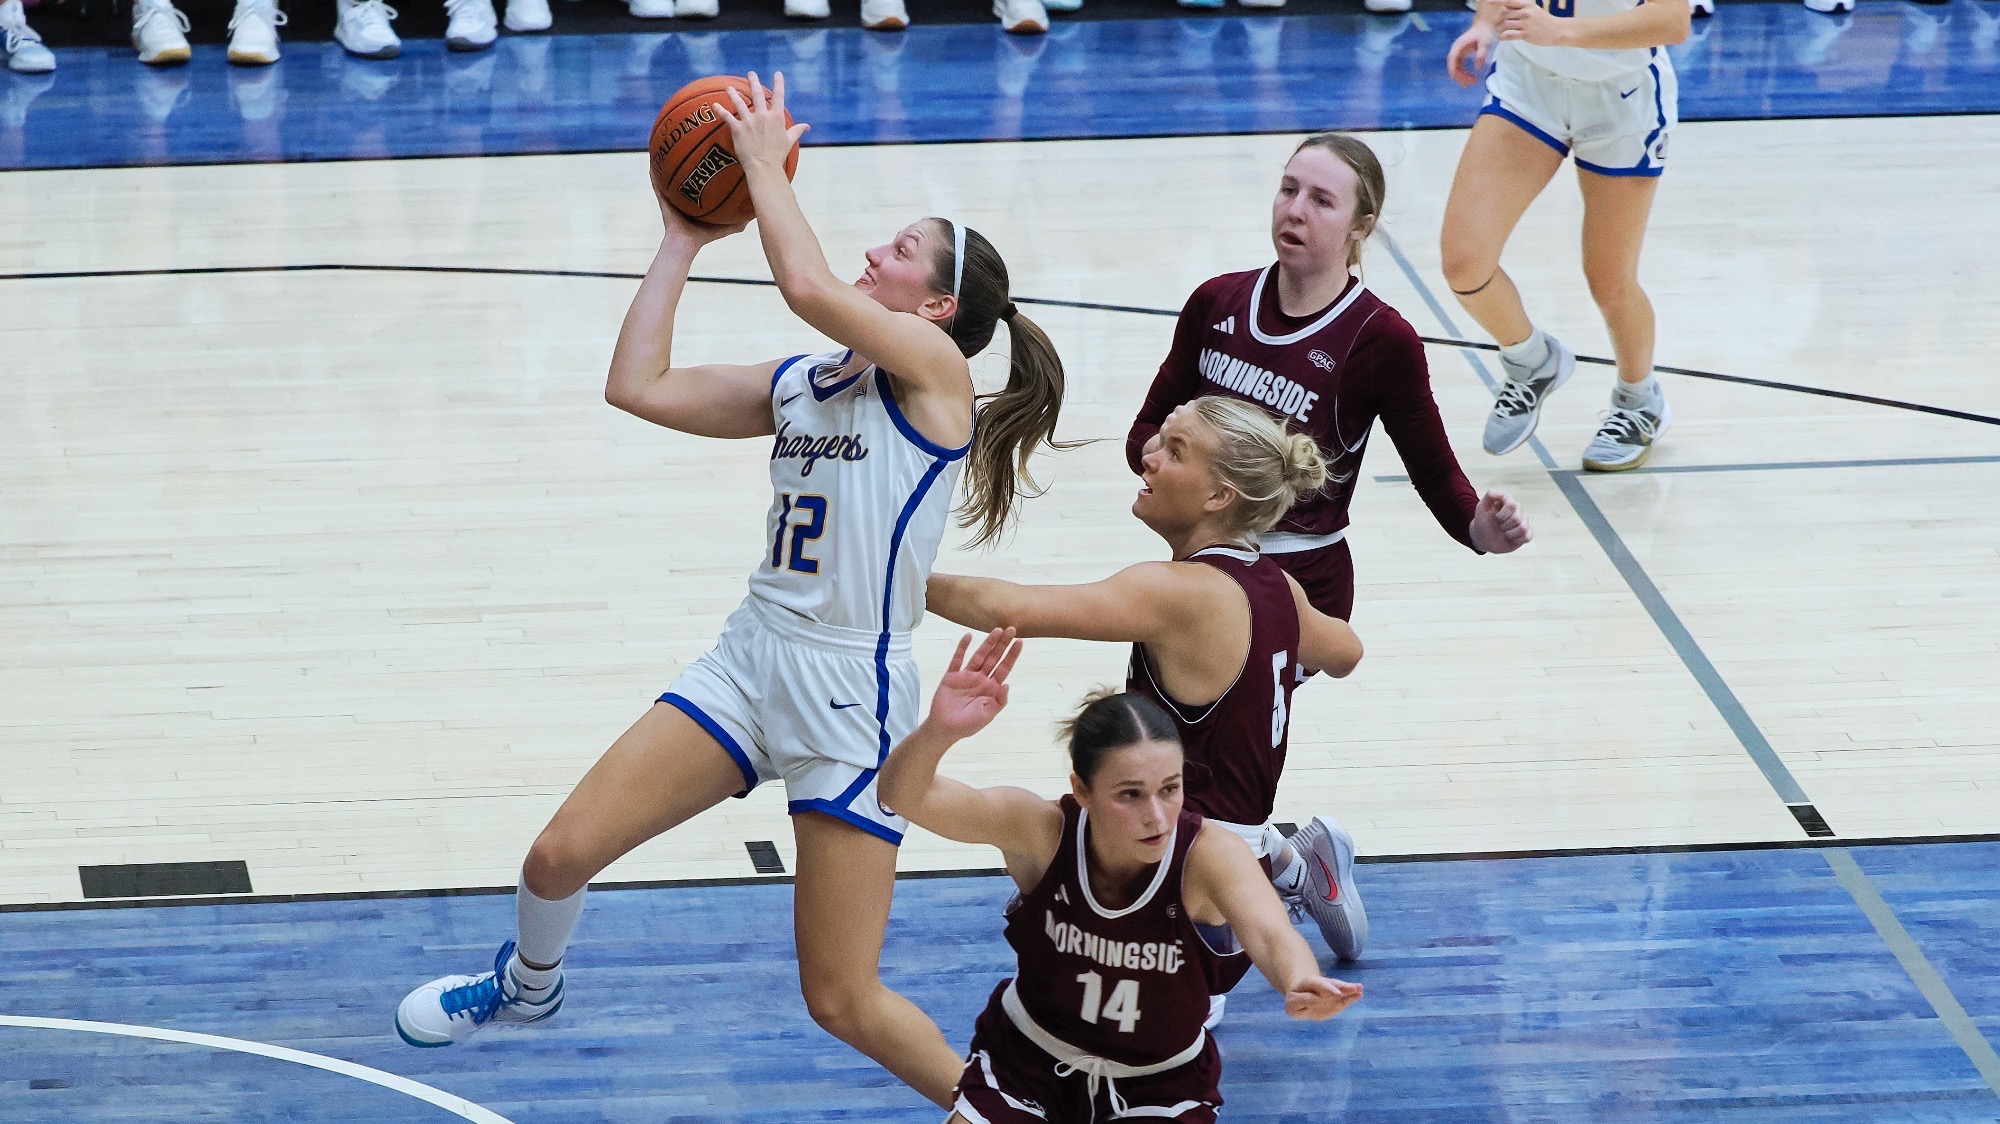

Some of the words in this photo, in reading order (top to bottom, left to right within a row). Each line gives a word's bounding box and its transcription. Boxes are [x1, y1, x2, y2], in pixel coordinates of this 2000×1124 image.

[678, 144, 738, 207] NAIA
[1310, 351, 1334, 370] GPAC
[770, 420, 869, 477] hargers
[771, 491, 830, 577] 12
[1271, 650, 1288, 748] 5
[1076, 969, 1142, 1033] 14
